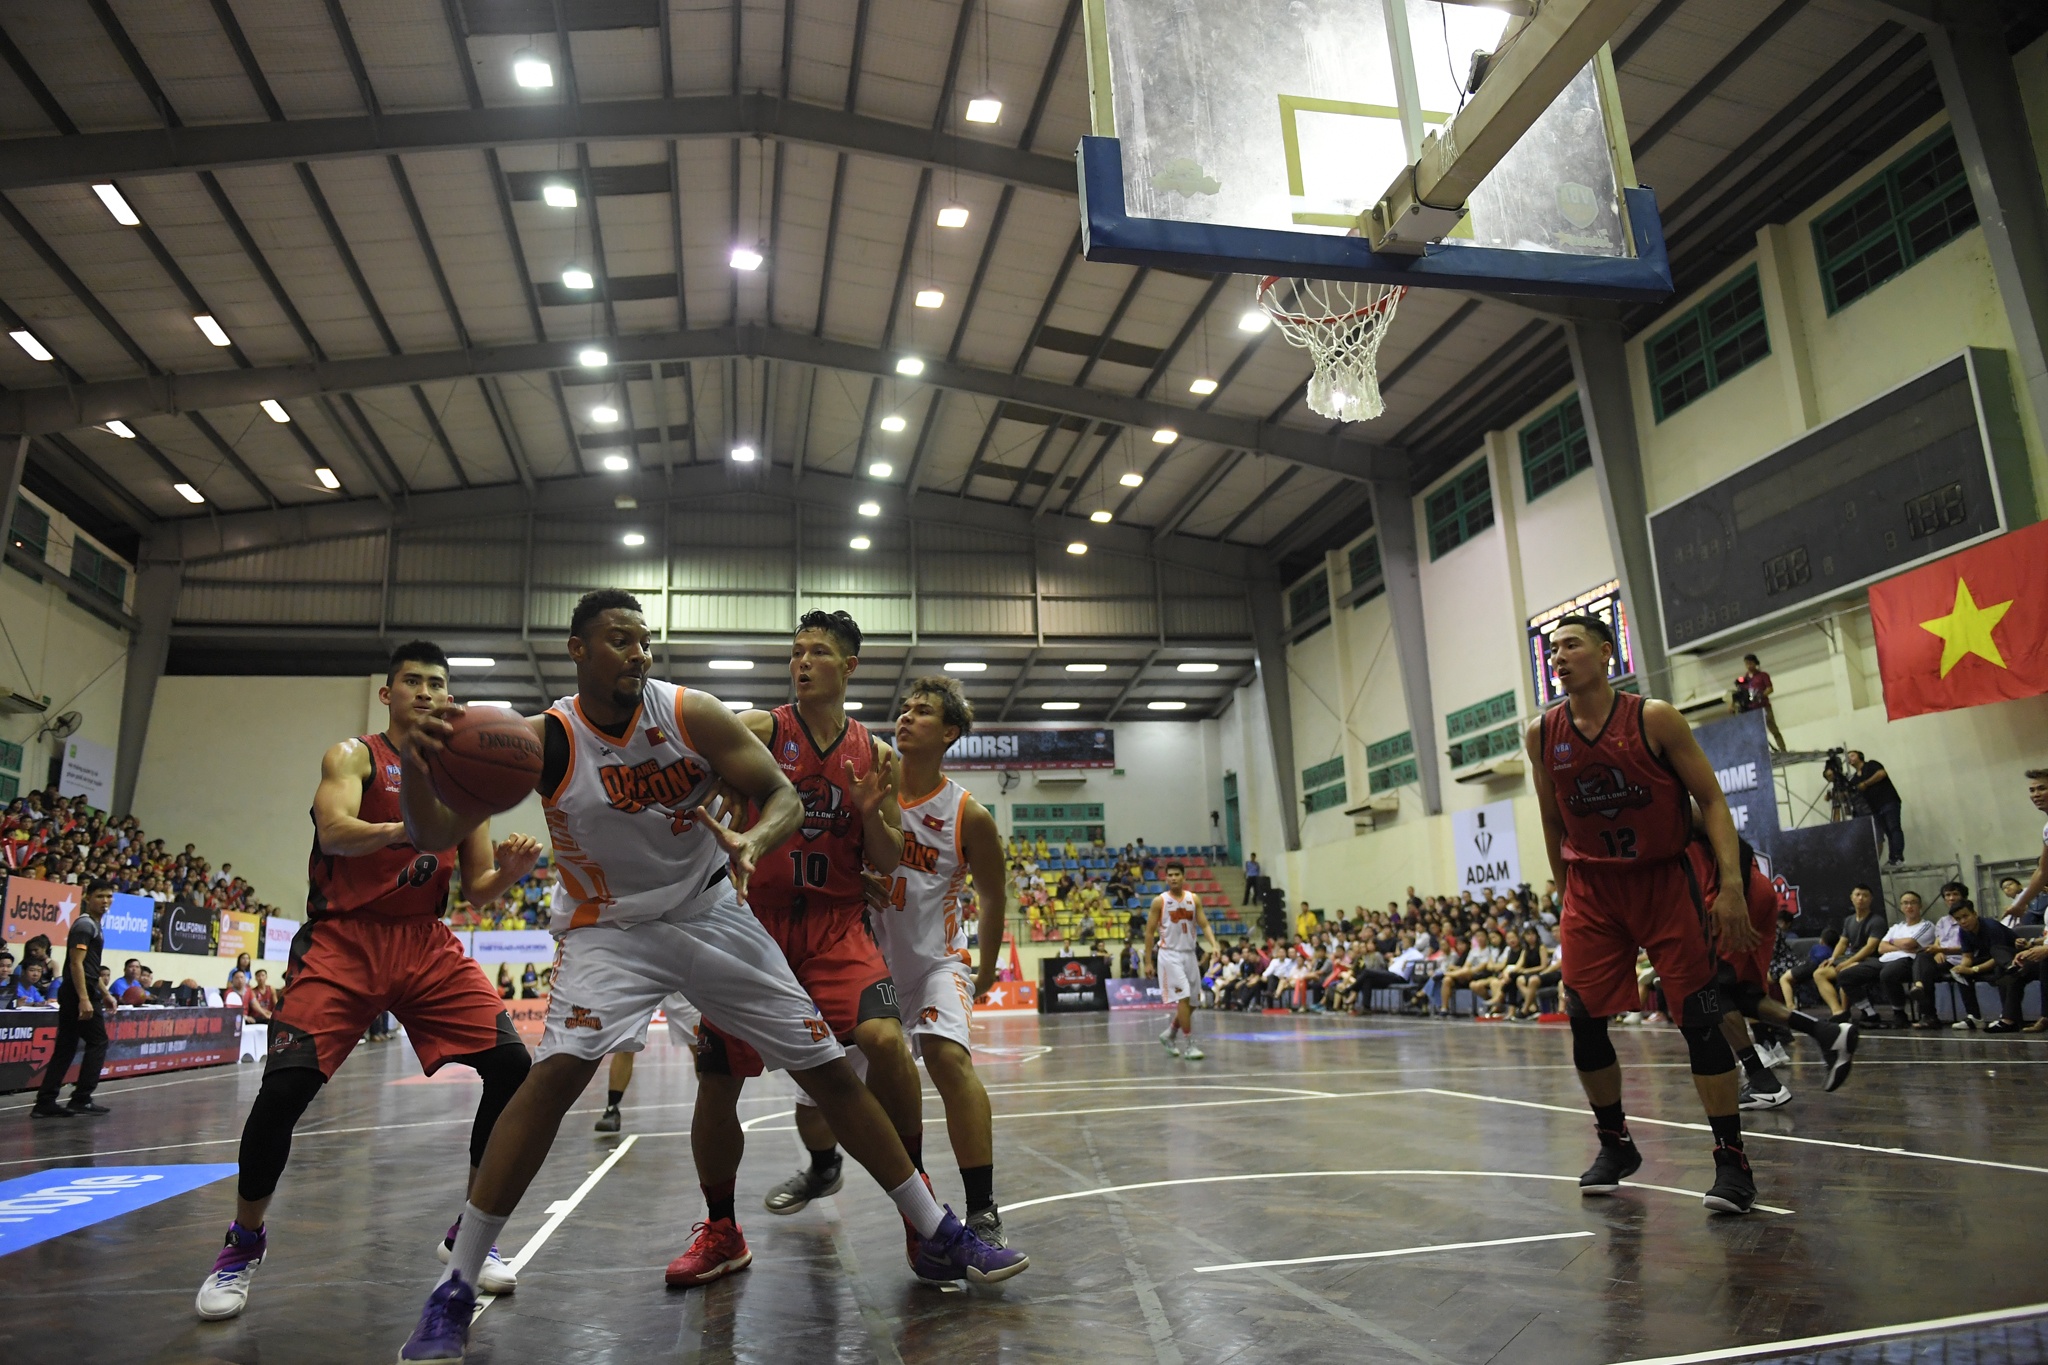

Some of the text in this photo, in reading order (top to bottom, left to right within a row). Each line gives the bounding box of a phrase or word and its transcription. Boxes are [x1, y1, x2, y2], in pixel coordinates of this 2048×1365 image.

[943, 735, 1019, 758] RIORS!
[1599, 826, 1638, 858] 12
[789, 851, 829, 888] 10
[1466, 860, 1510, 885] ADAM
[10, 895, 59, 923] Jetstar
[175, 920, 207, 934] CALIFORNIA
[1697, 990, 1720, 1013] 12
[8, 1027, 33, 1040] LONG
